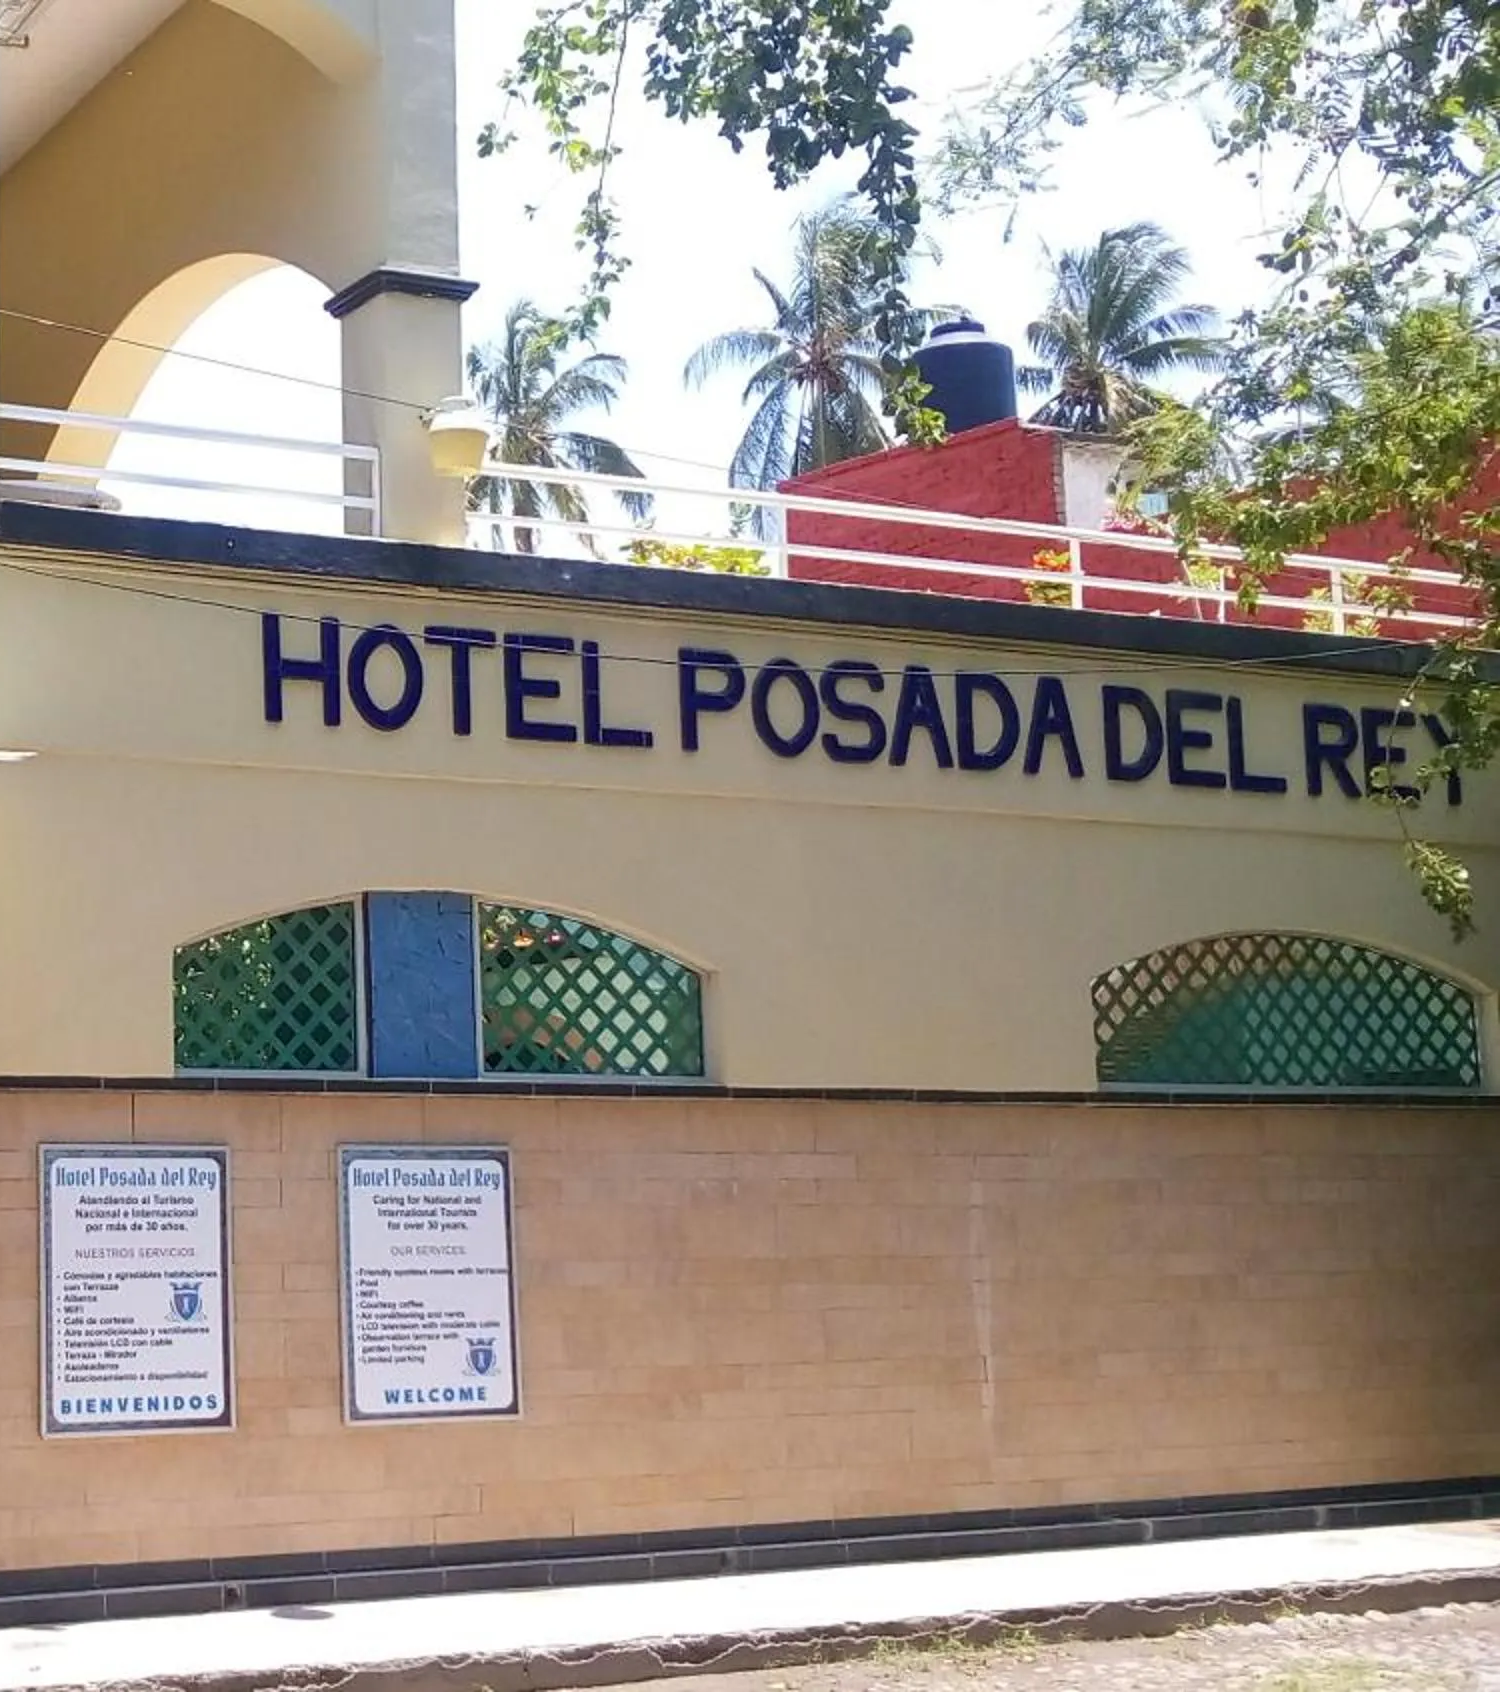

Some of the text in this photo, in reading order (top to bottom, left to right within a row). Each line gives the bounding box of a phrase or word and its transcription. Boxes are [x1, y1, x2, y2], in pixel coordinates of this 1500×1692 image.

[261, 611, 653, 748] HOTEL
[677, 646, 1085, 779] POSADA
[1101, 685, 1288, 794] DEL
[55, 1167, 217, 1191] Hotel Posada del Rey
[353, 1168, 500, 1191] Hotel Posada del Rey
[79, 1195, 194, 1205] Atendiendo al Turismo
[373, 1195, 482, 1206] Caring for National and
[75, 1208, 198, 1218] Nacional e Internacional
[377, 1208, 438, 1217] International
[86, 1223, 103, 1233] por
[106, 1221, 127, 1231] más
[130, 1221, 143, 1231] de
[146, 1221, 157, 1231] 30
[387, 1221, 400, 1230] for
[403, 1222, 424, 1230] over
[427, 1220, 438, 1229] 30
[75, 1248, 195, 1259] NUESTROS SERVICIOS
[390, 1245, 467, 1257] OUR SERVICES
[63, 1316, 83, 1325] Café
[86, 1316, 97, 1324] de
[63, 1328, 82, 1337] Aire
[84, 1327, 148, 1336] acondicionado
[150, 1328, 155, 1336] y
[110, 1338, 129, 1347] LCD
[64, 1352, 97, 1360] Terraza
[384, 1386, 487, 1405] WELCOME
[60, 1394, 217, 1415] BIENVENIDOS
